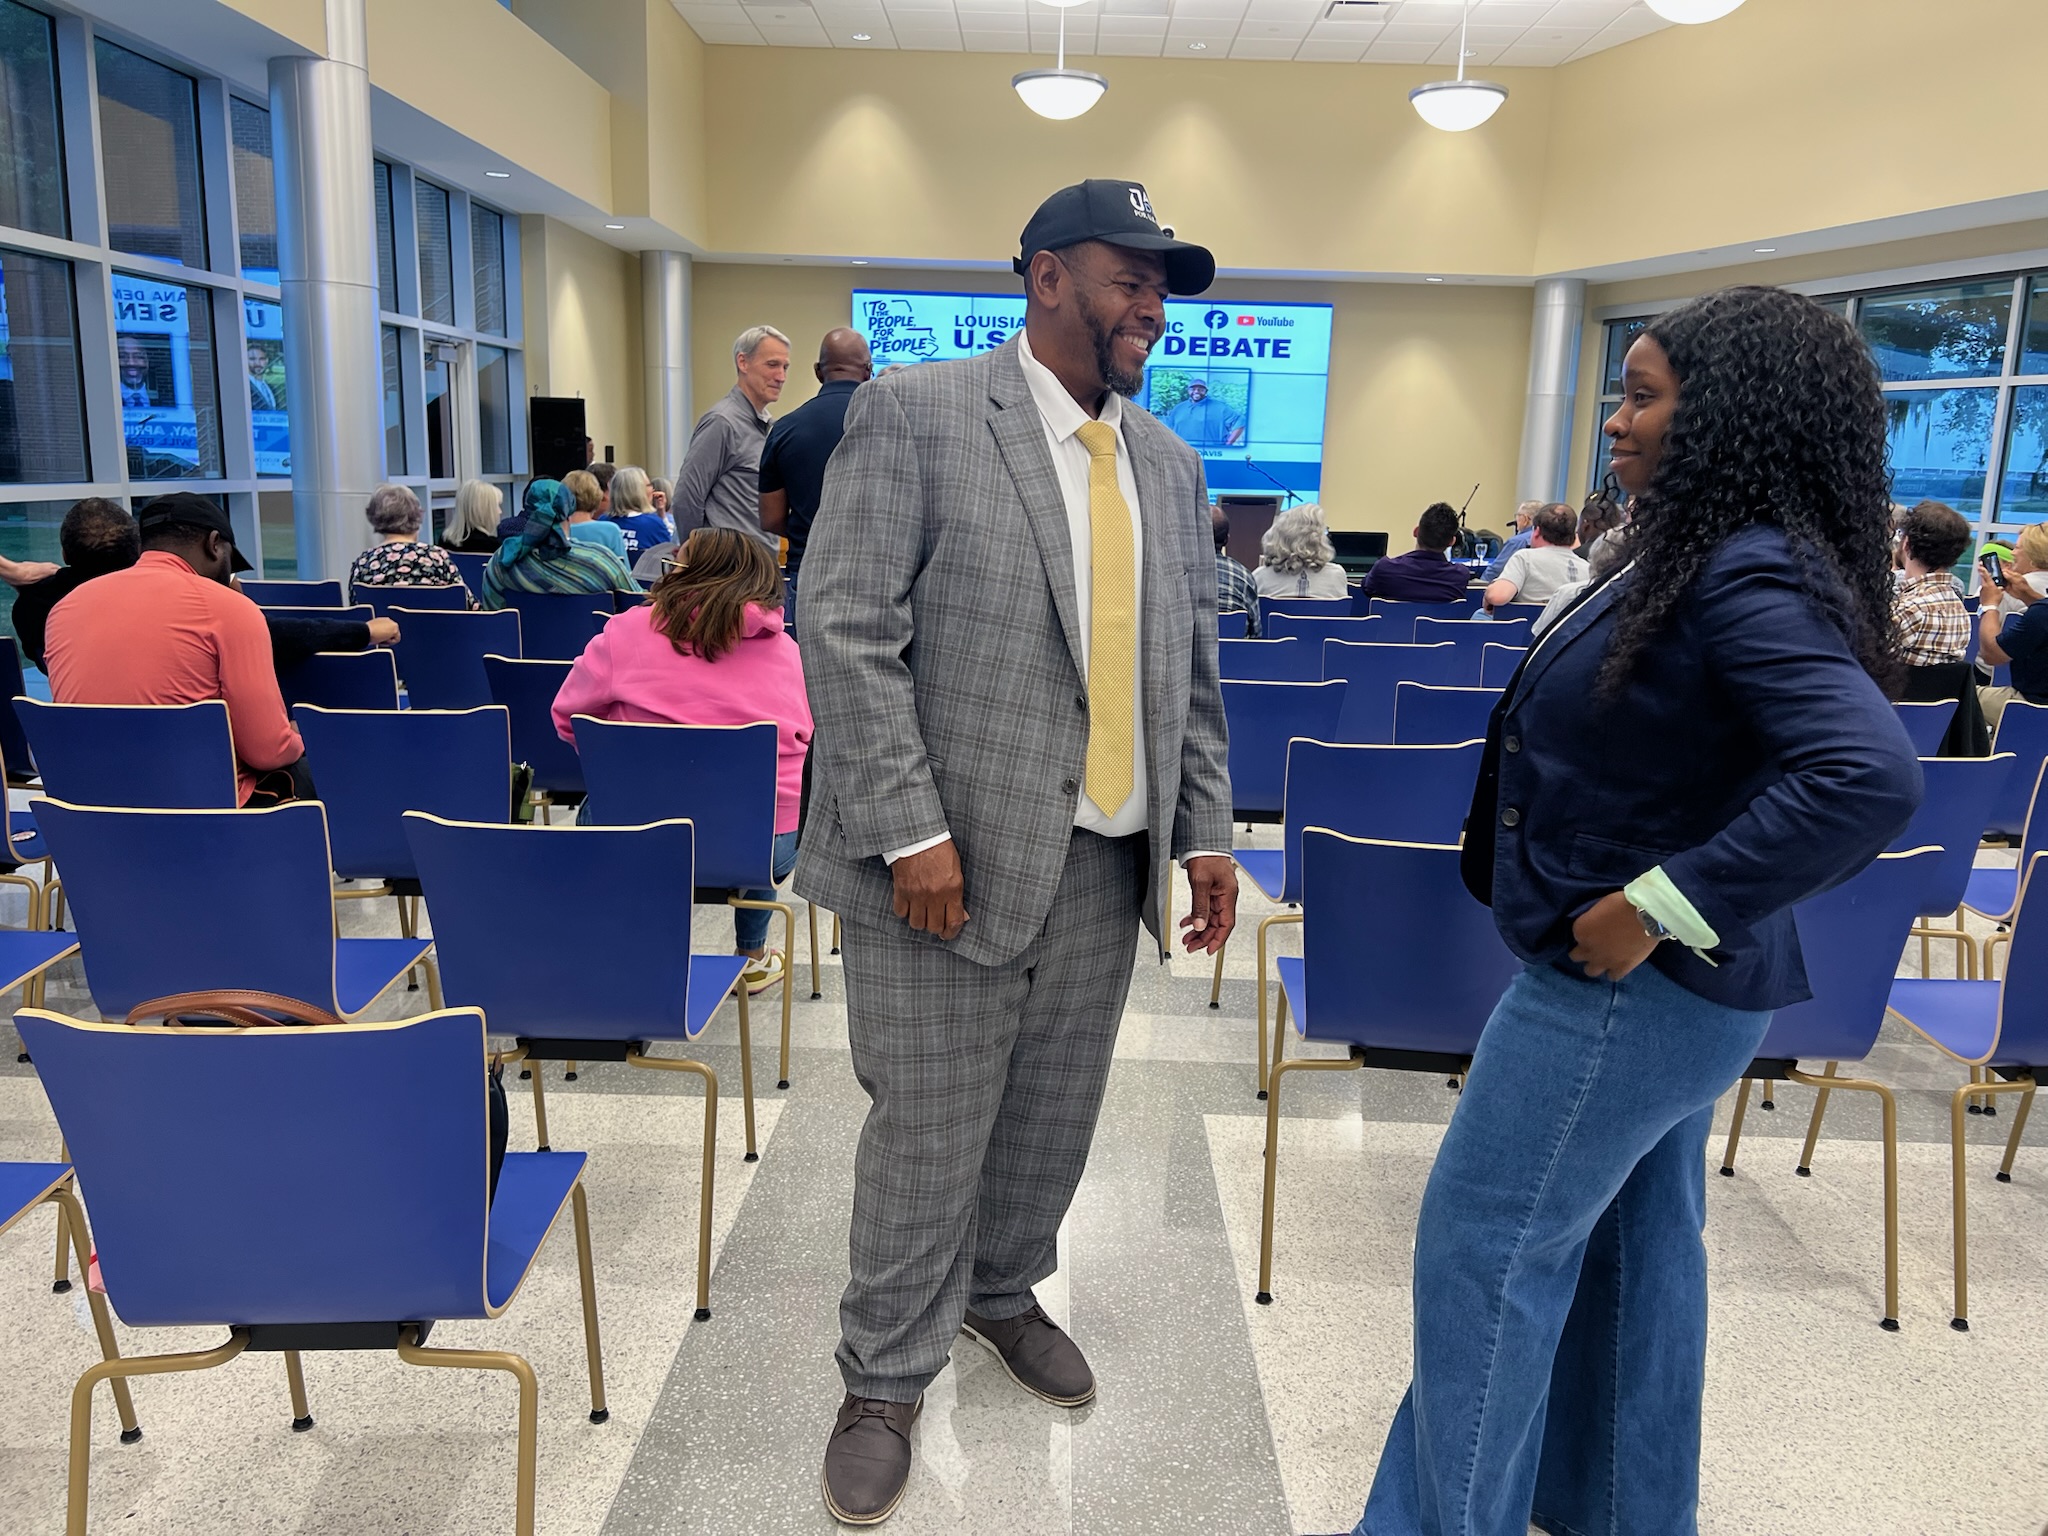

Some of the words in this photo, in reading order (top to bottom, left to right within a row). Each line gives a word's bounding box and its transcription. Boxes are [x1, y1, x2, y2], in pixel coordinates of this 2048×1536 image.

[868, 300, 887, 316] TO
[1166, 321, 1184, 333] IC
[1257, 316, 1295, 327] YouTube
[873, 328, 894, 339] FOR
[869, 337, 928, 355] PEOPLE
[1164, 336, 1292, 359] DEBATE
